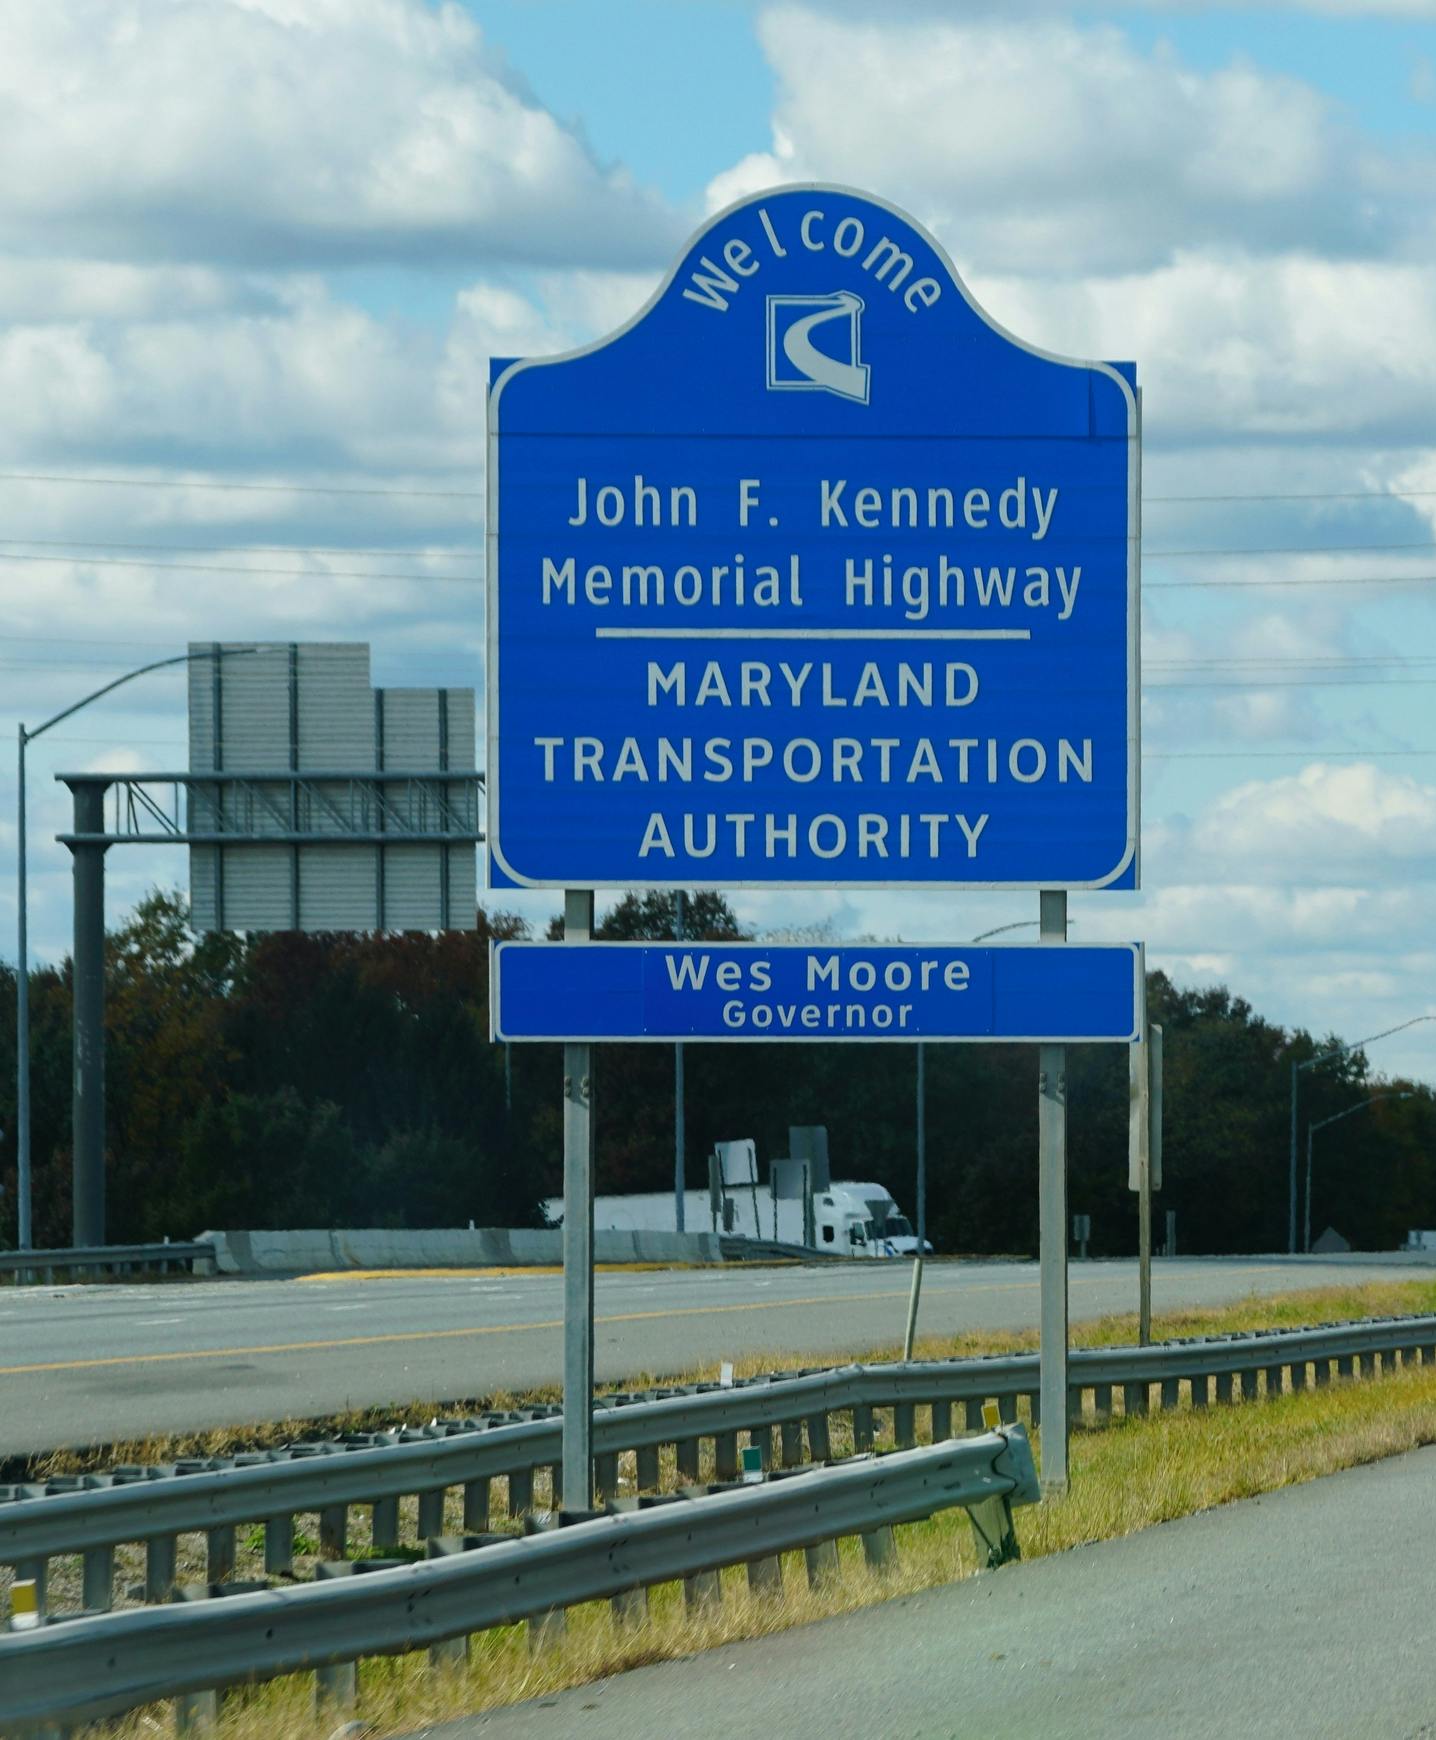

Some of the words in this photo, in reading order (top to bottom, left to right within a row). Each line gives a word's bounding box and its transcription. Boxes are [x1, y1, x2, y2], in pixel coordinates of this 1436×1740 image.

[683, 209, 942, 312] Welcome
[569, 476, 698, 526] John
[739, 480, 779, 526] F.
[821, 478, 1059, 540] Kennedy
[542, 555, 803, 606] Memorial
[845, 555, 1082, 620] Highway
[647, 662, 979, 707] MARYLAND
[534, 737, 1093, 783] TRANSPORTATION
[638, 813, 990, 859] AUTHORITY
[665, 955, 772, 991] Wes
[807, 956, 970, 991] Moore
[723, 1000, 913, 1028] Governor
